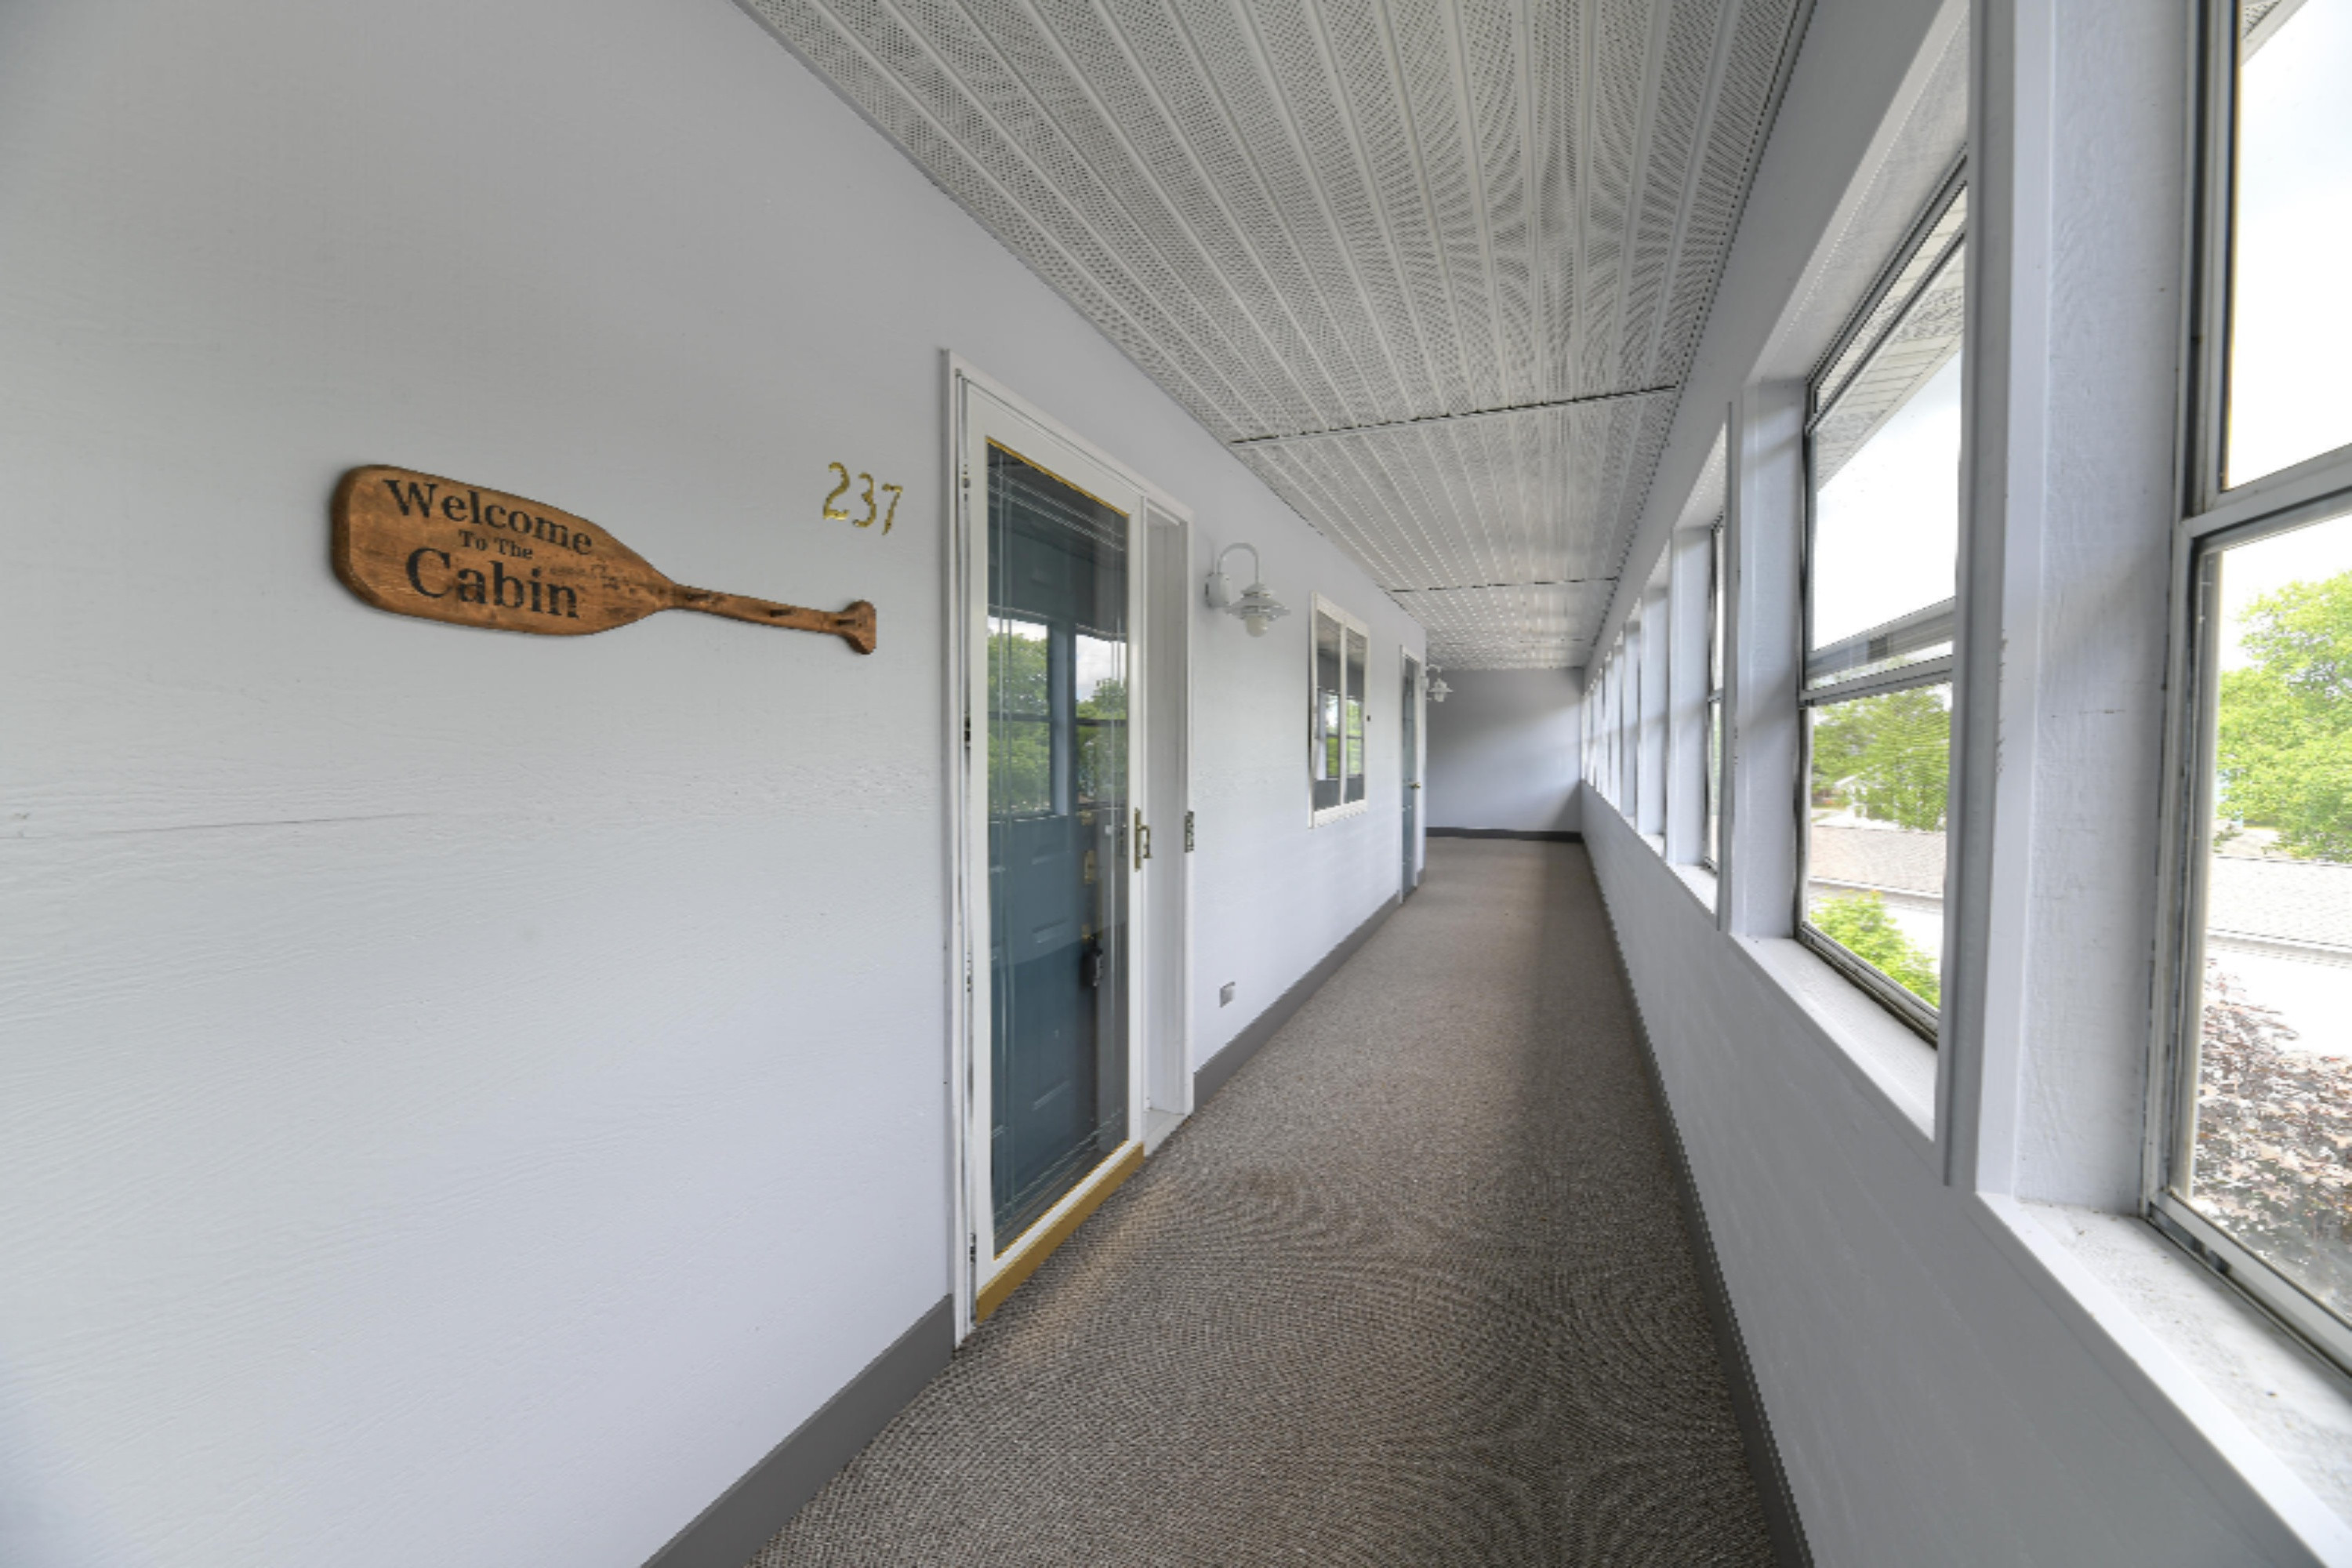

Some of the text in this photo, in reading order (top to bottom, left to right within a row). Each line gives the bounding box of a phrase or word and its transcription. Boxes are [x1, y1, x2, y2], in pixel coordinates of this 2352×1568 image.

[383, 479, 592, 555] Welcome
[822, 461, 903, 535] 237
[459, 528, 533, 559] To The
[406, 547, 579, 619] Cabin
